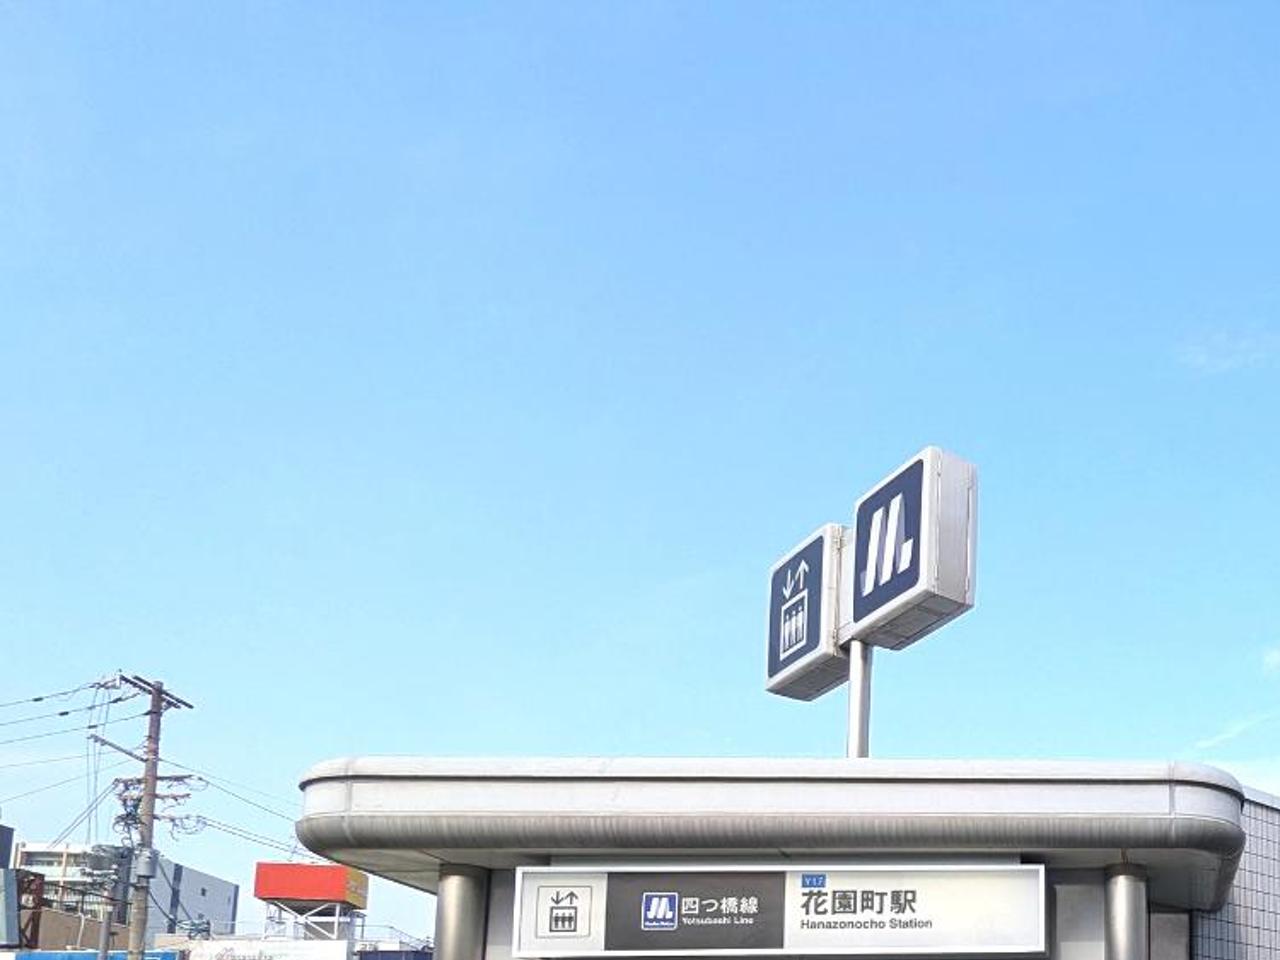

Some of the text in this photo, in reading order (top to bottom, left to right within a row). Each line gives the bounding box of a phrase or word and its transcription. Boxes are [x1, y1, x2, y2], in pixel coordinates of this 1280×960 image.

[681, 896, 759, 914] 四つ橋線
[800, 889, 917, 916] 花園町駅
[734, 916, 755, 925] Line
[800, 918, 933, 930] Hanazonocho Station
